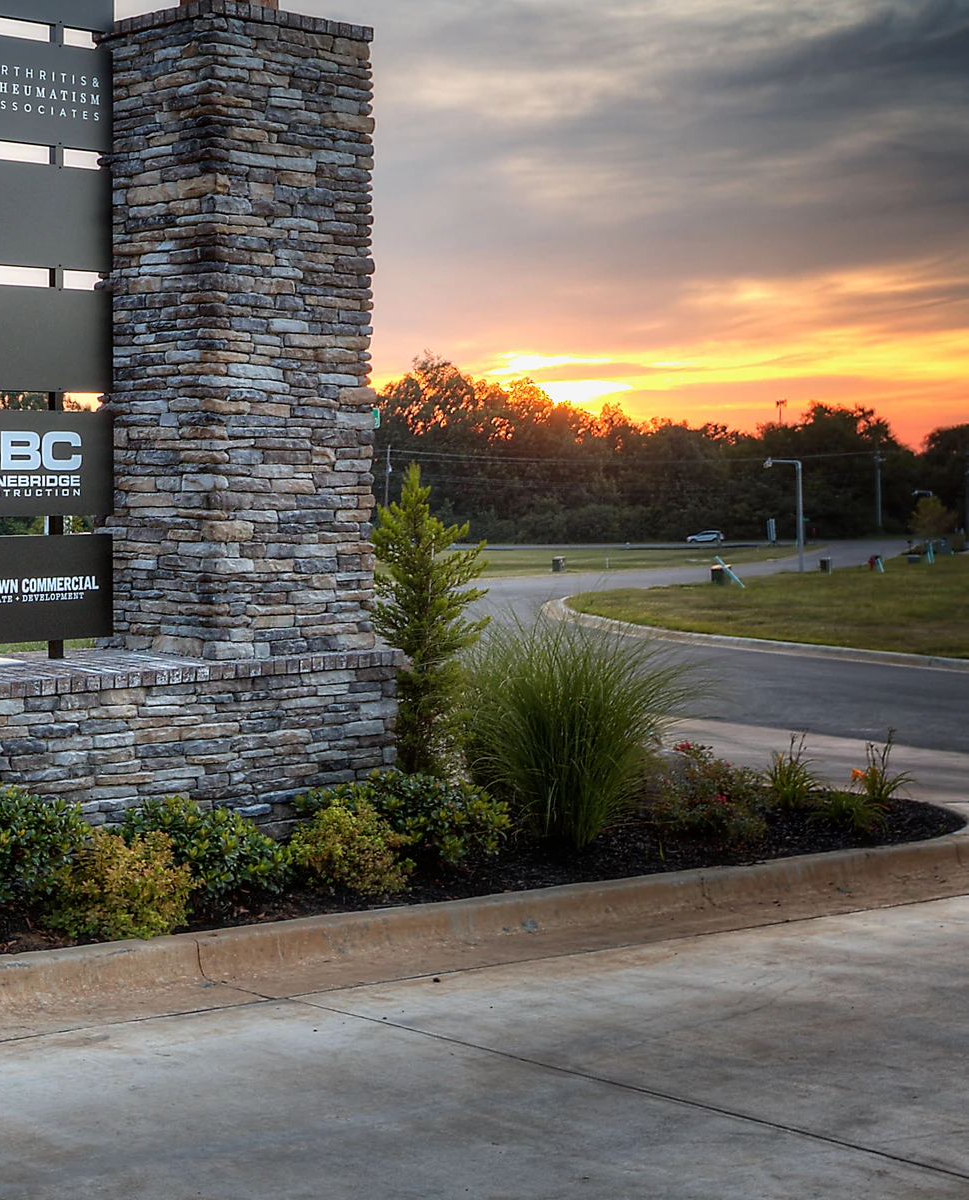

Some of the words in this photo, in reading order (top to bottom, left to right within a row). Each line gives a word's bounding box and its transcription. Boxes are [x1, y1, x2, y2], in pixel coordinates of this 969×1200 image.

[92, 77, 100, 88] &
[21, 575, 100, 593] COMMERCIAL
[22, 591, 85, 602] DEVELOPMENT
